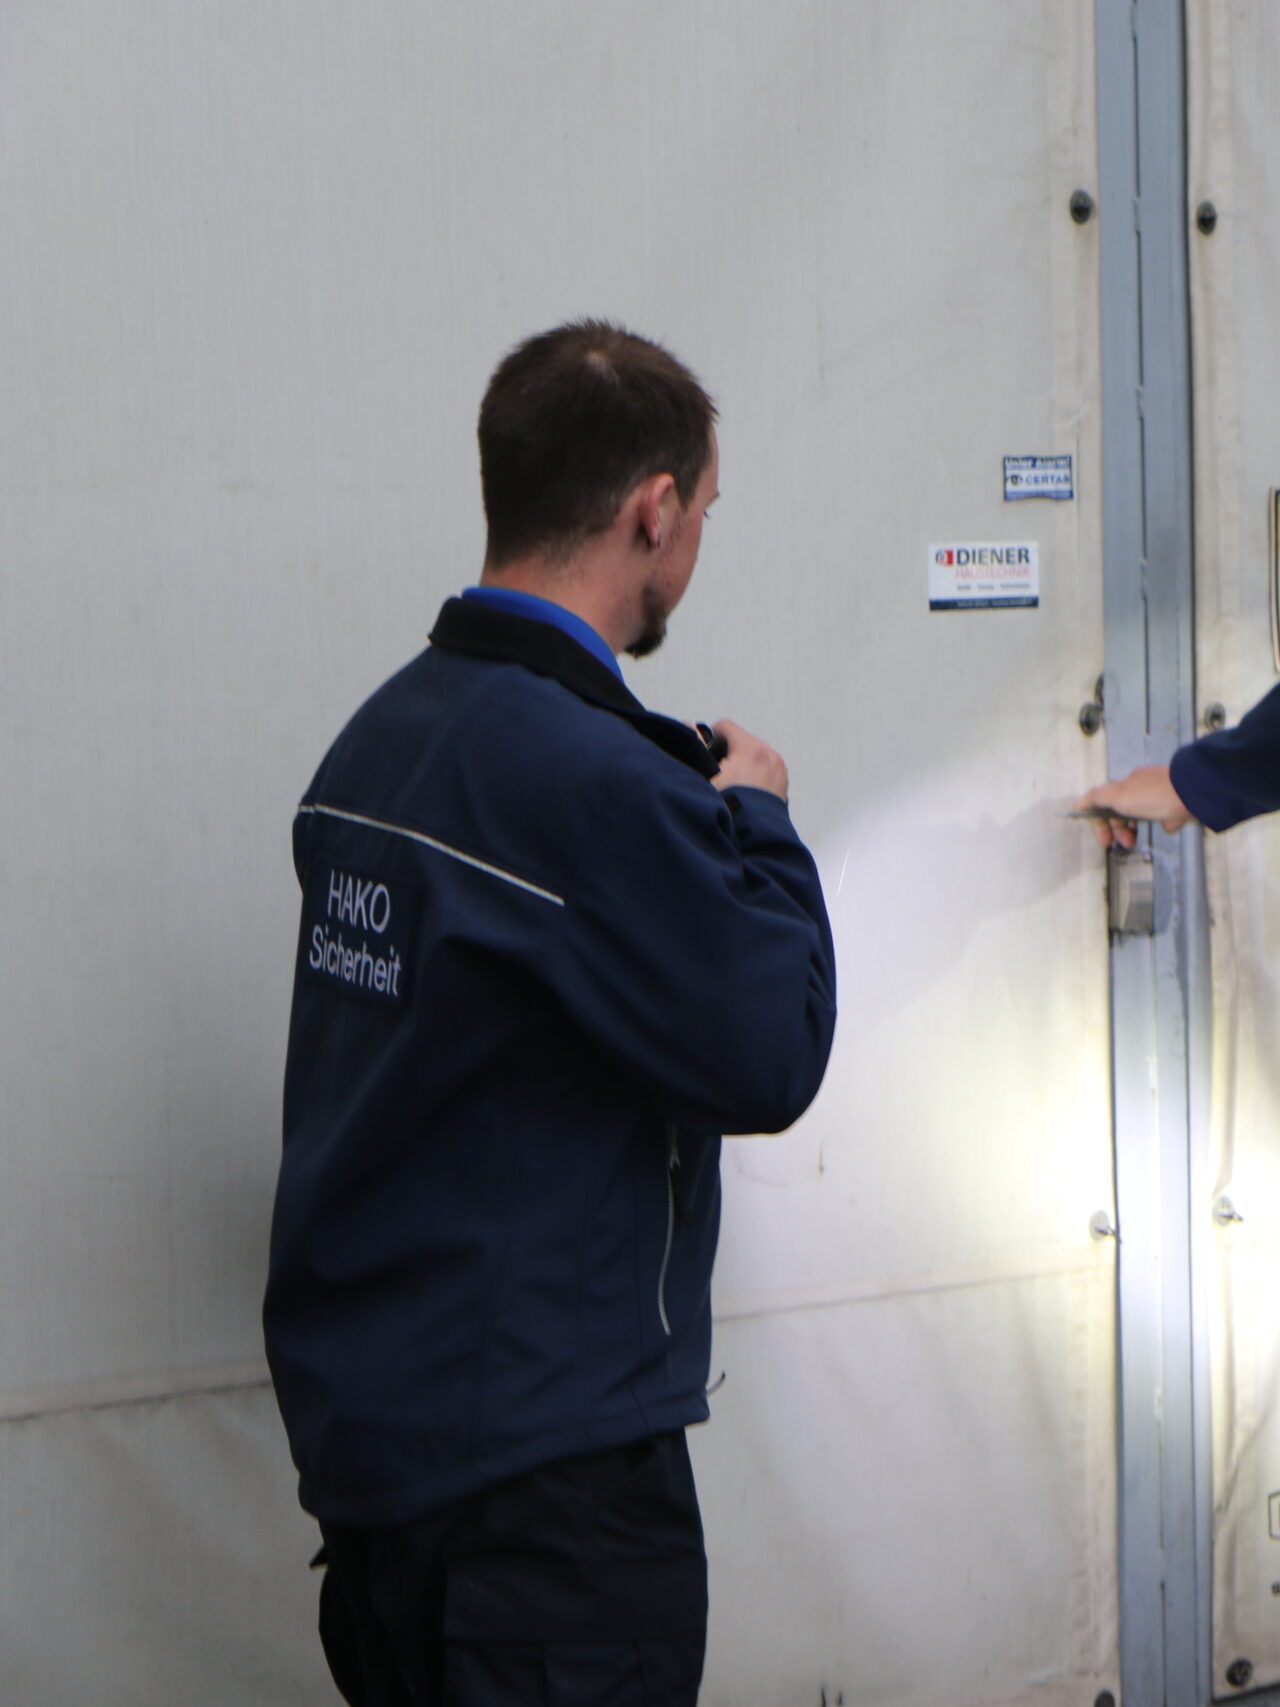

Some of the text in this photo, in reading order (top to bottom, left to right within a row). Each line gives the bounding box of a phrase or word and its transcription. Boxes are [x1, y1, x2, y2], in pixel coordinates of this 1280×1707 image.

[956, 548, 1030, 566] DIENER
[328, 869, 390, 934] HAKO
[309, 923, 402, 997] Sicherheit
